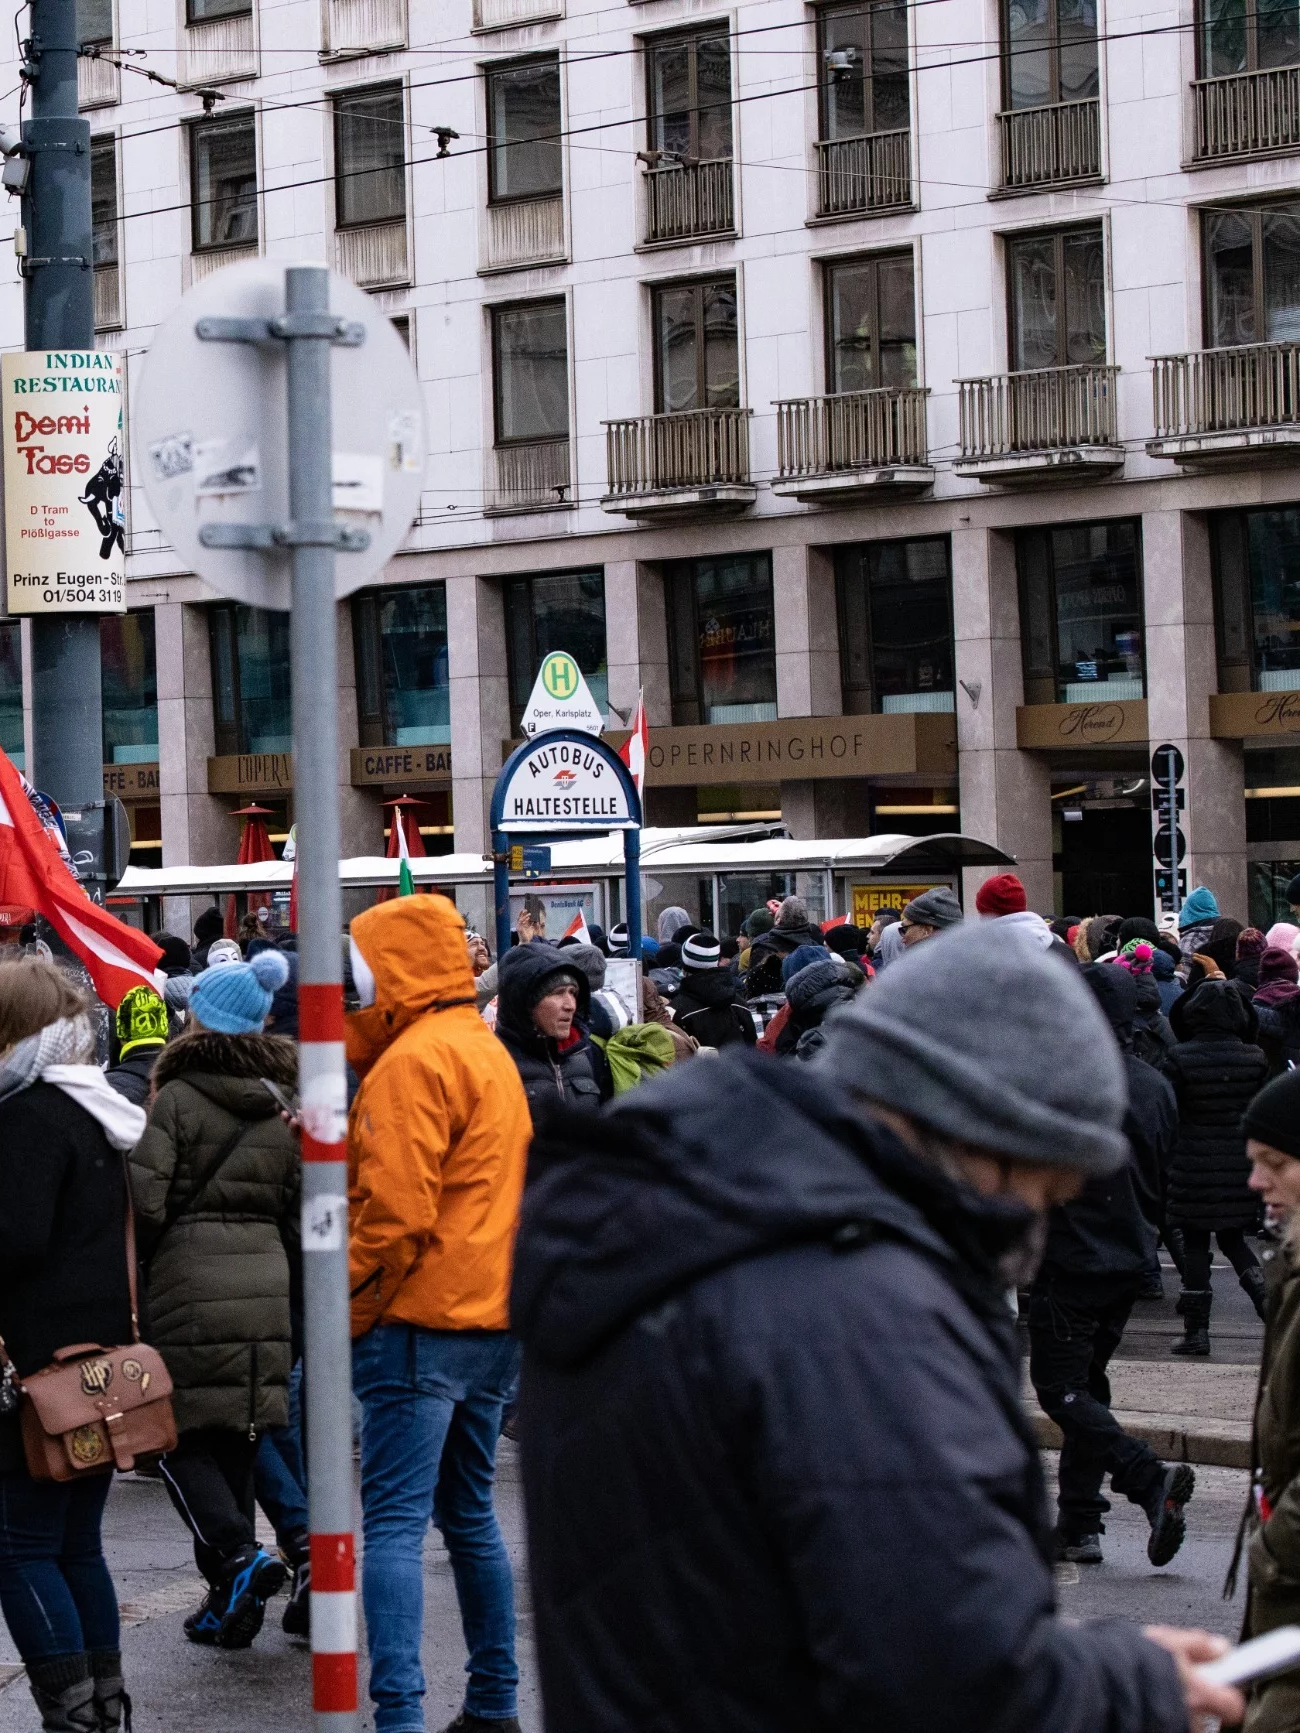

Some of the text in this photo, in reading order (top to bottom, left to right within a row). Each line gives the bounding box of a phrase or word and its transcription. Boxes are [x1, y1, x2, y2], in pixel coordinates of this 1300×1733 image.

[46, 353, 113, 369] INDIAN
[15, 404, 91, 443] Demi
[17, 446, 91, 475] Tass
[30, 506, 69, 515] D Tram
[44, 517, 55, 526] to
[21, 529, 80, 540] Plößlgasse
[13, 573, 50, 587] Prinz
[43, 589, 122, 603] 01/504 3119
[551, 663, 570, 691] H
[533, 708, 592, 718] Oper, Karlsplatz
[649, 734, 863, 768] OPERNRINGHOF
[365, 750, 412, 775] CAFFÈ
[528, 746, 604, 778] AUTOBUS
[514, 797, 617, 815] HALTESTELLE
[855, 893, 911, 910] MEHR-
